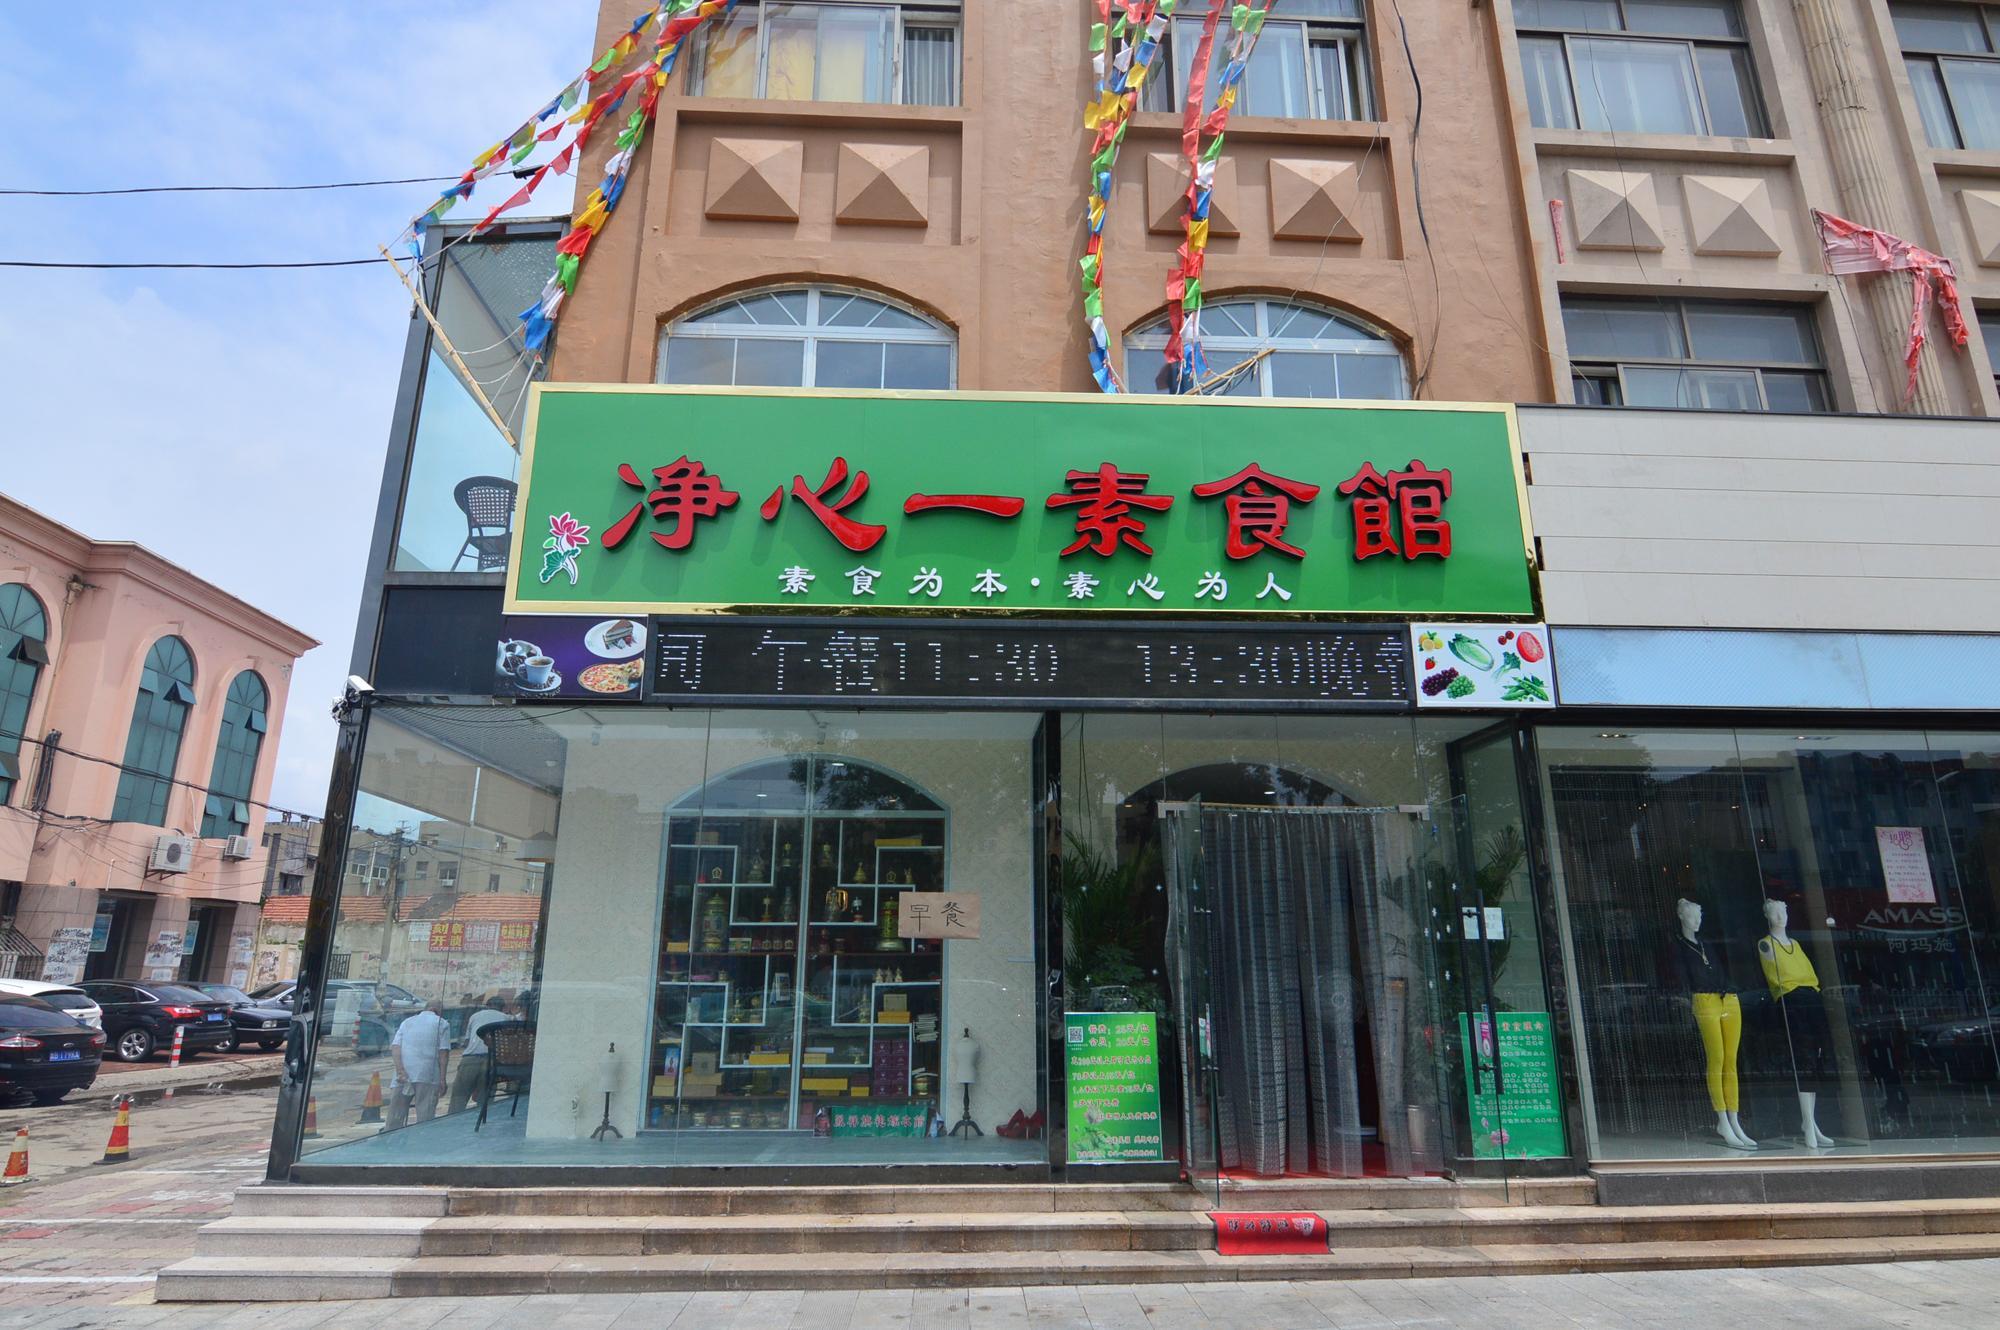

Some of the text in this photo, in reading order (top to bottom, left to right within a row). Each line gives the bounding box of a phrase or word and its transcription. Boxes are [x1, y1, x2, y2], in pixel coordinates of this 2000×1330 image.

[910, 901, 966, 932] 早餐
[1864, 906, 1966, 924] AMASS
[1886, 937, 1956, 953] 阿玛施
